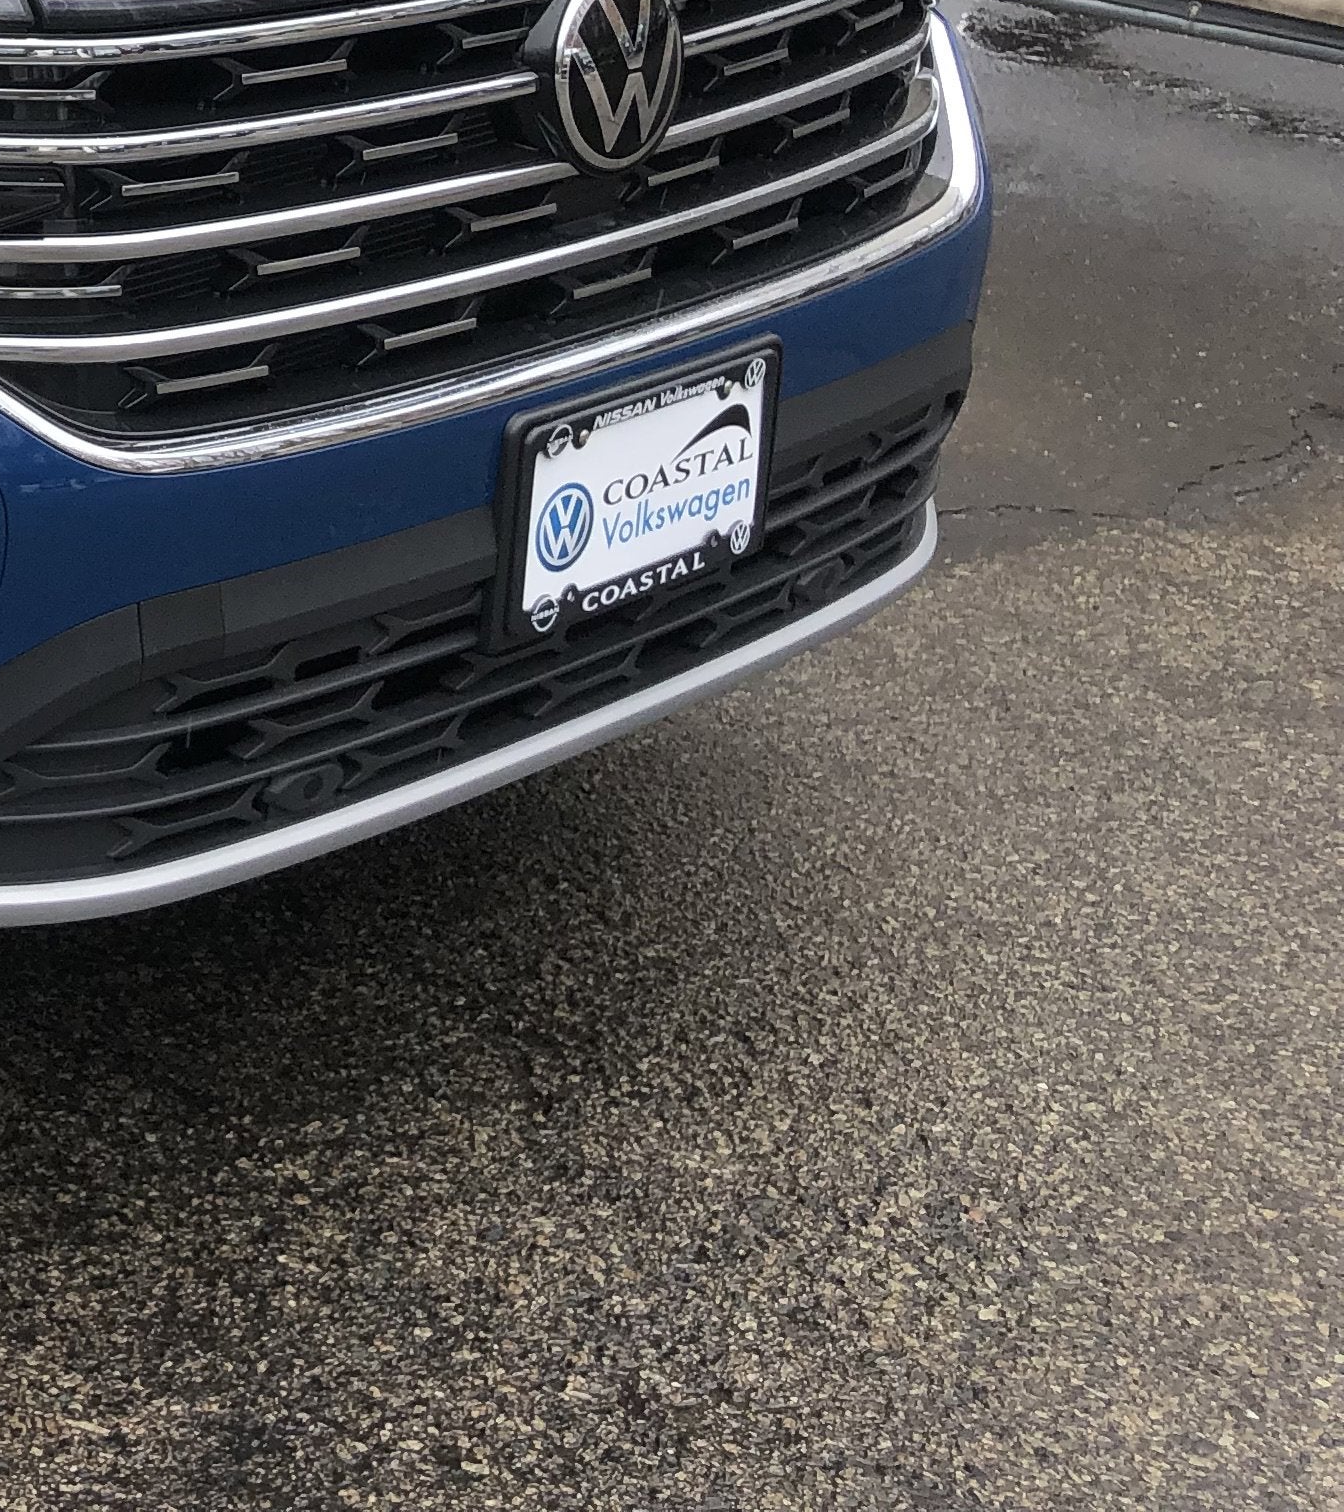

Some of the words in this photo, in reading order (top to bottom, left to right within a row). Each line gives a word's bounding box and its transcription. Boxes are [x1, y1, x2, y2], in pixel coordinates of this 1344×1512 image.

[593, 395, 657, 430] NISSAN
[660, 375, 726, 407] Volkswagen
[602, 438, 754, 506] COASTAL
[602, 478, 750, 549] Volkswagen
[582, 552, 706, 612] COASTAL
